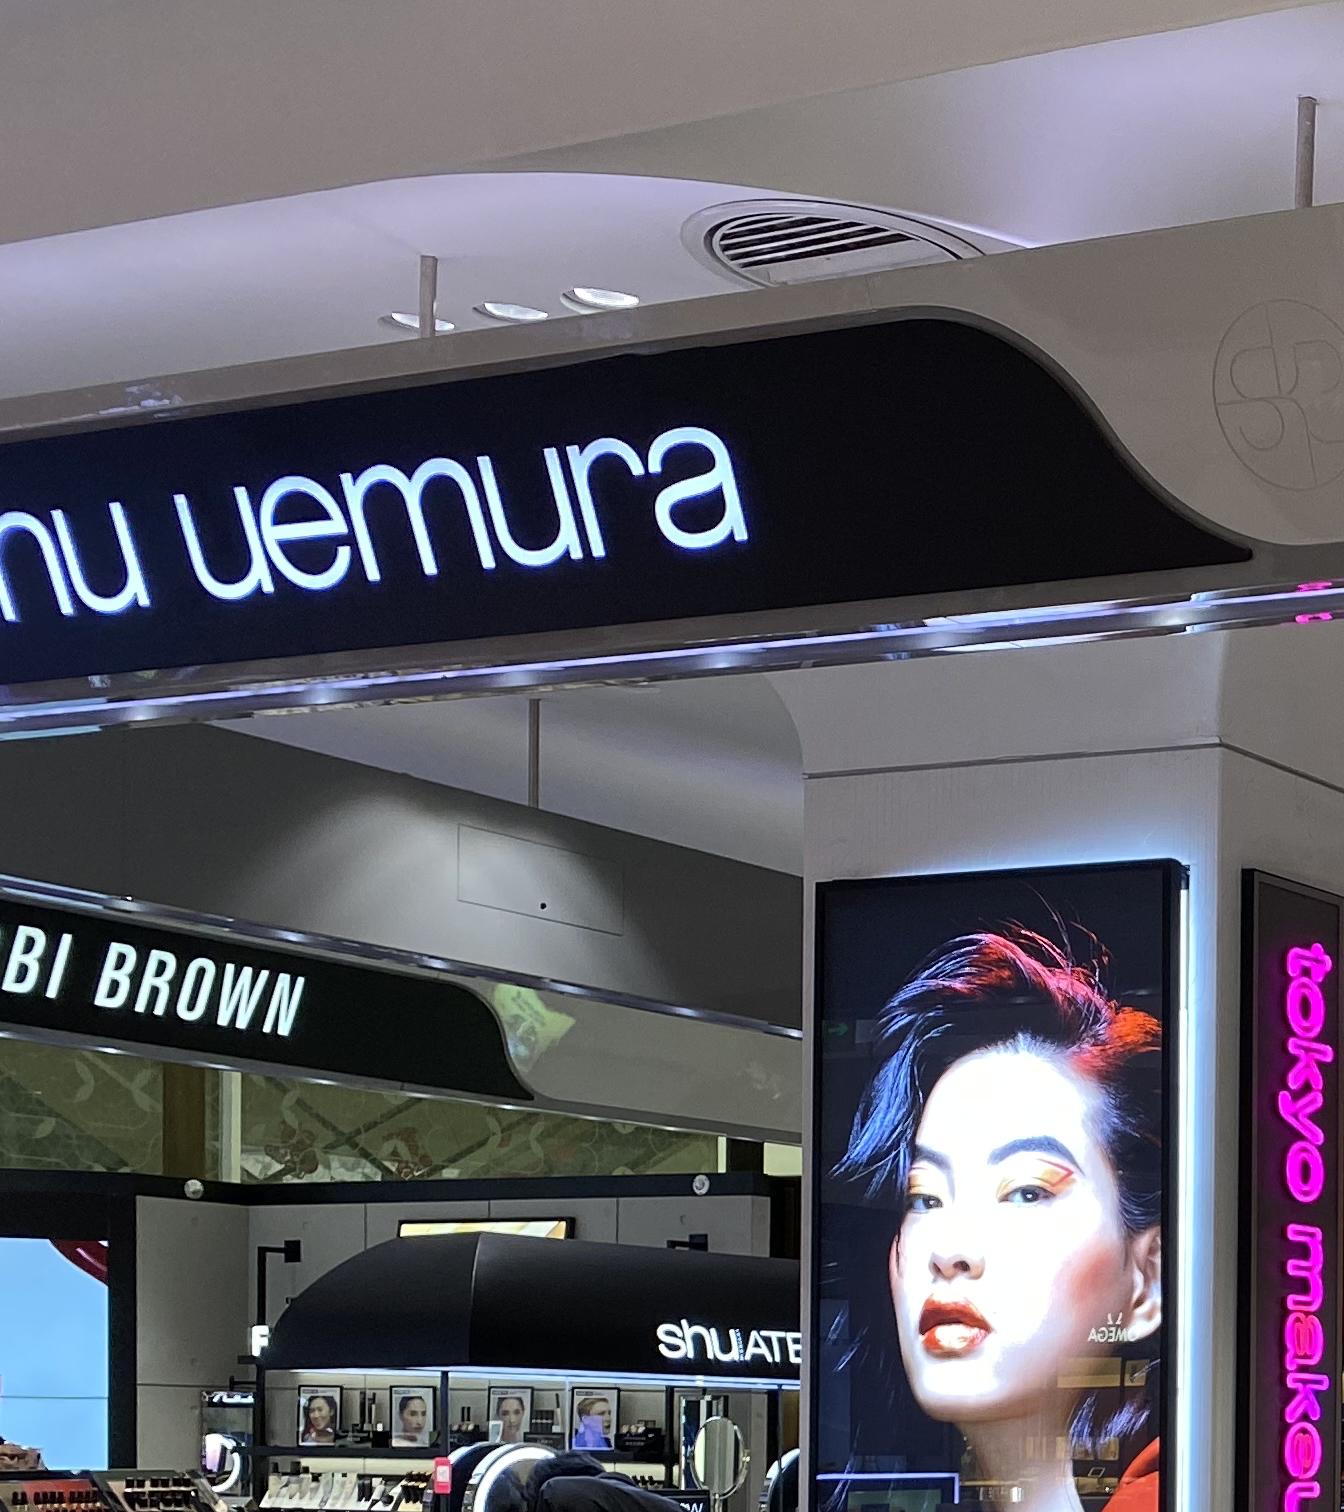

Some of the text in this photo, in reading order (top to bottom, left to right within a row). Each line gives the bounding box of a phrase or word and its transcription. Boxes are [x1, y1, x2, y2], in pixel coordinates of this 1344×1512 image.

[174, 426, 748, 600] uemura
[1, 925, 305, 1037] BI BROWN
[1279, 943, 1334, 1203] tokyo
